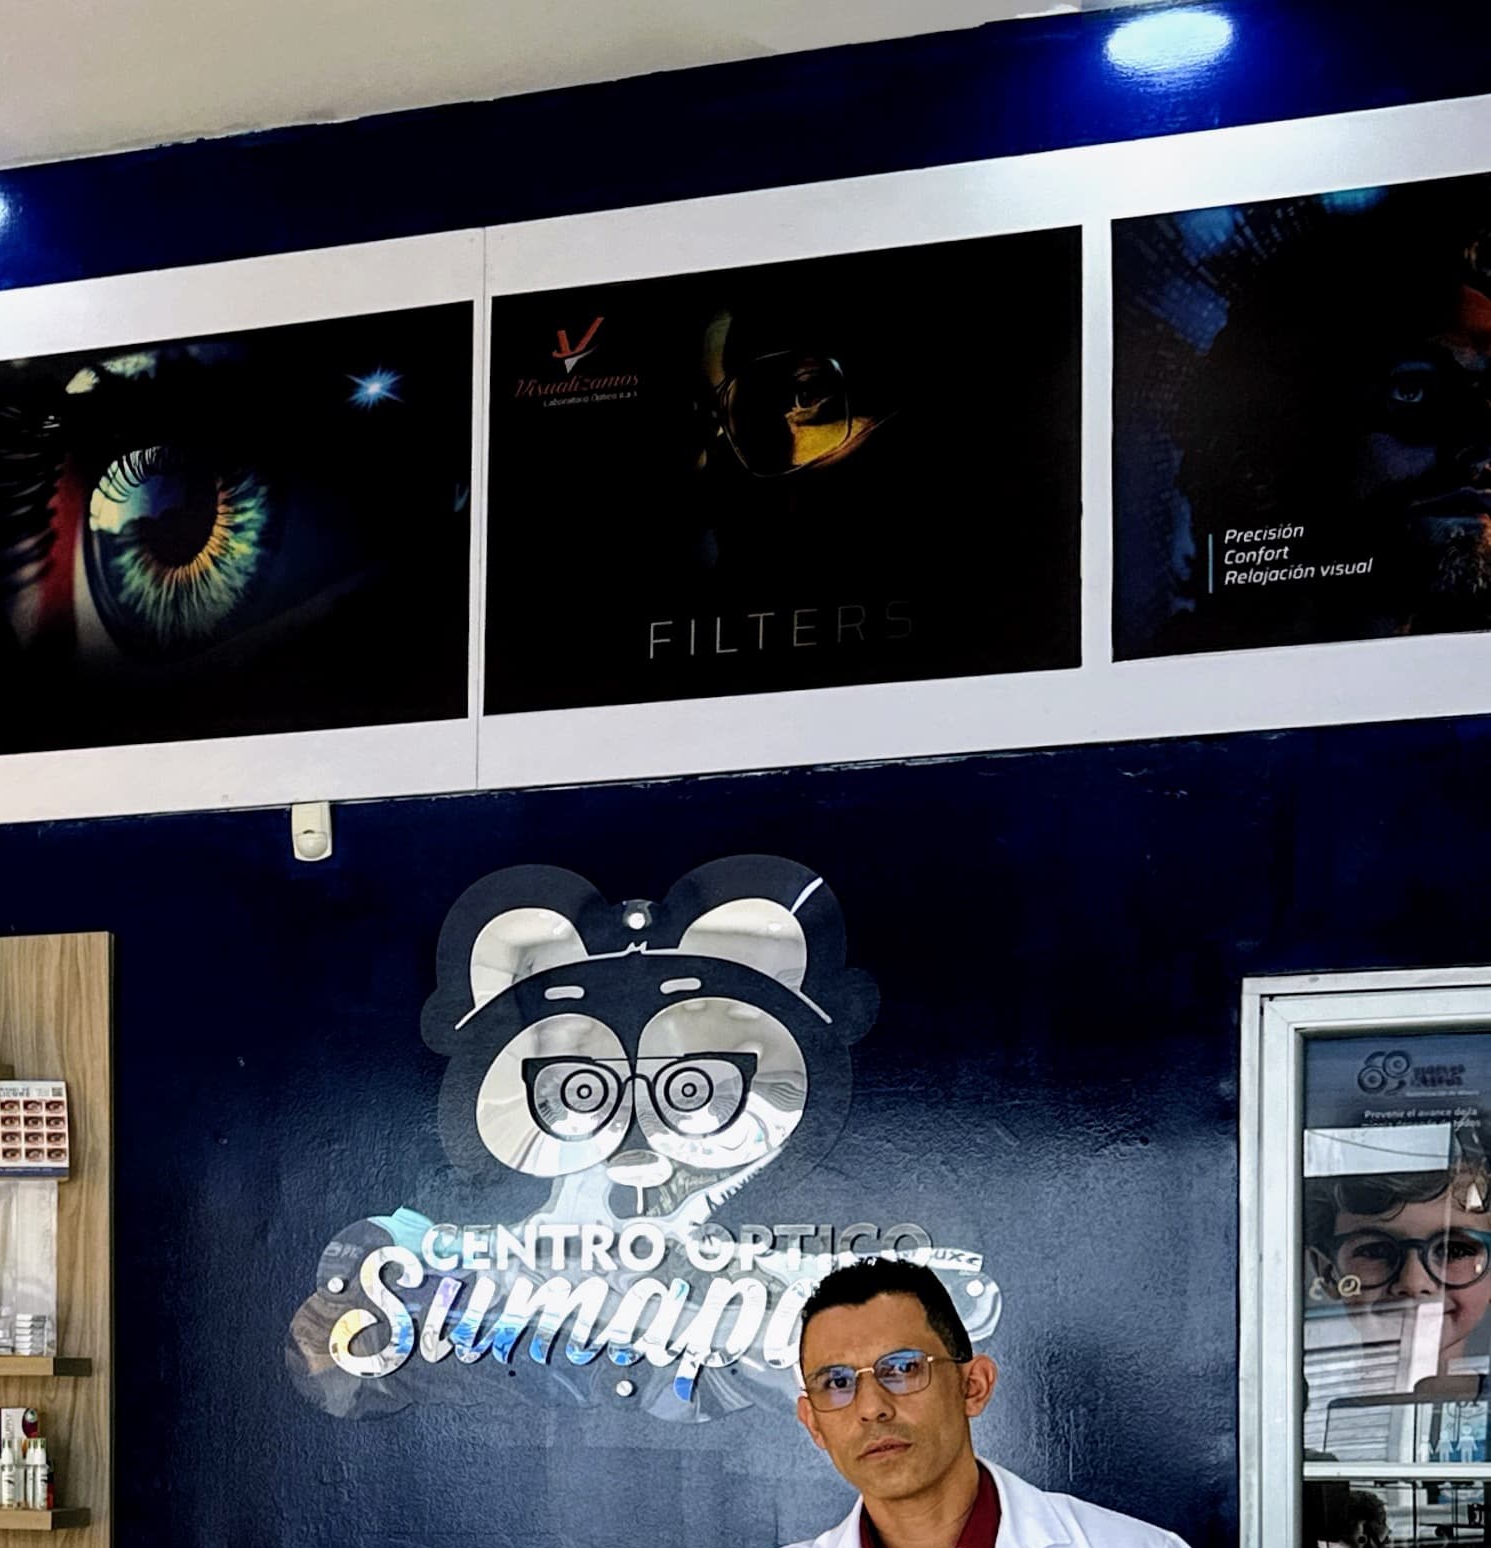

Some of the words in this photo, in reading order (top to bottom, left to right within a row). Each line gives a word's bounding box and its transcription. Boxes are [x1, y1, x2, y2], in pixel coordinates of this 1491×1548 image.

[1224, 523, 1305, 544] Precisión
[1224, 546, 1290, 565] Confort
[1224, 563, 1316, 586] Relajación
[1320, 557, 1374, 577] visual
[650, 601, 912, 660] FILTERS
[422, 1223, 665, 1271] CENTRO
